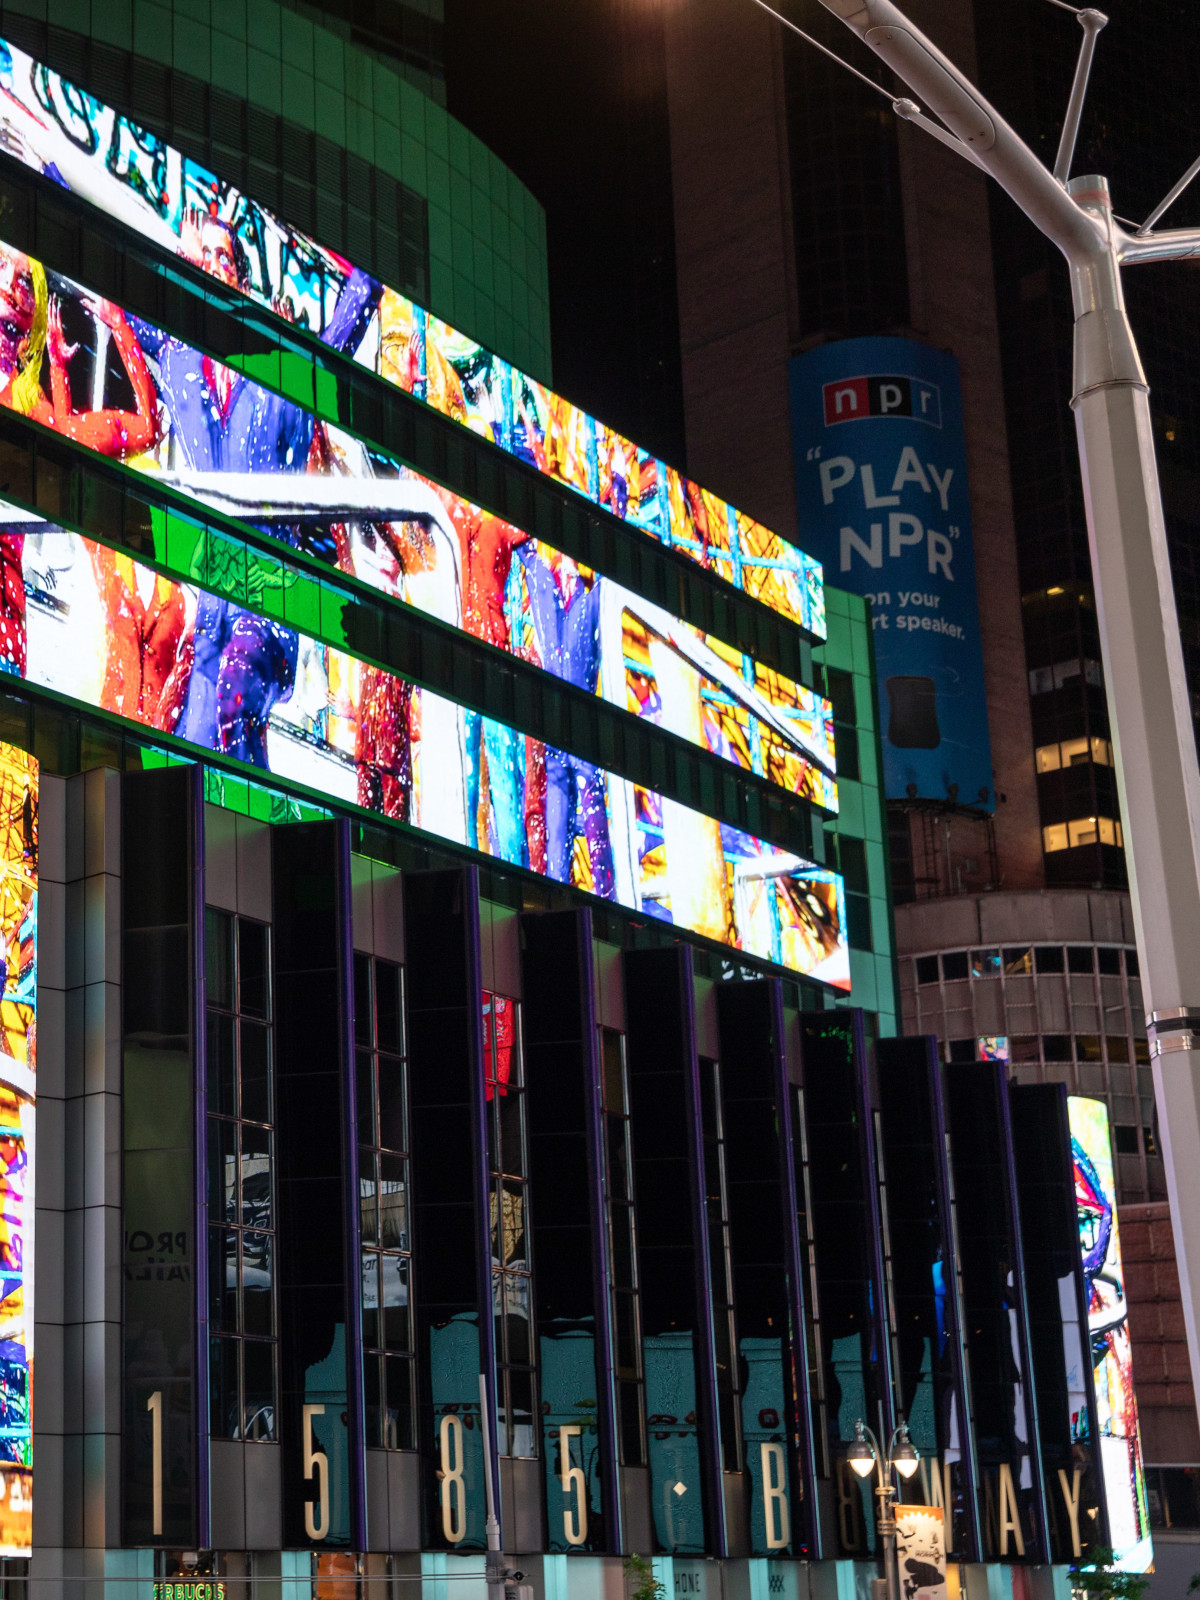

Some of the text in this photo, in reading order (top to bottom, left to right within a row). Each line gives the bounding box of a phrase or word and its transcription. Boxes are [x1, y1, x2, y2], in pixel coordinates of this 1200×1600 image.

[834, 383, 933, 415] npr
[897, 591, 941, 608] your
[895, 614, 966, 641] speaker.
